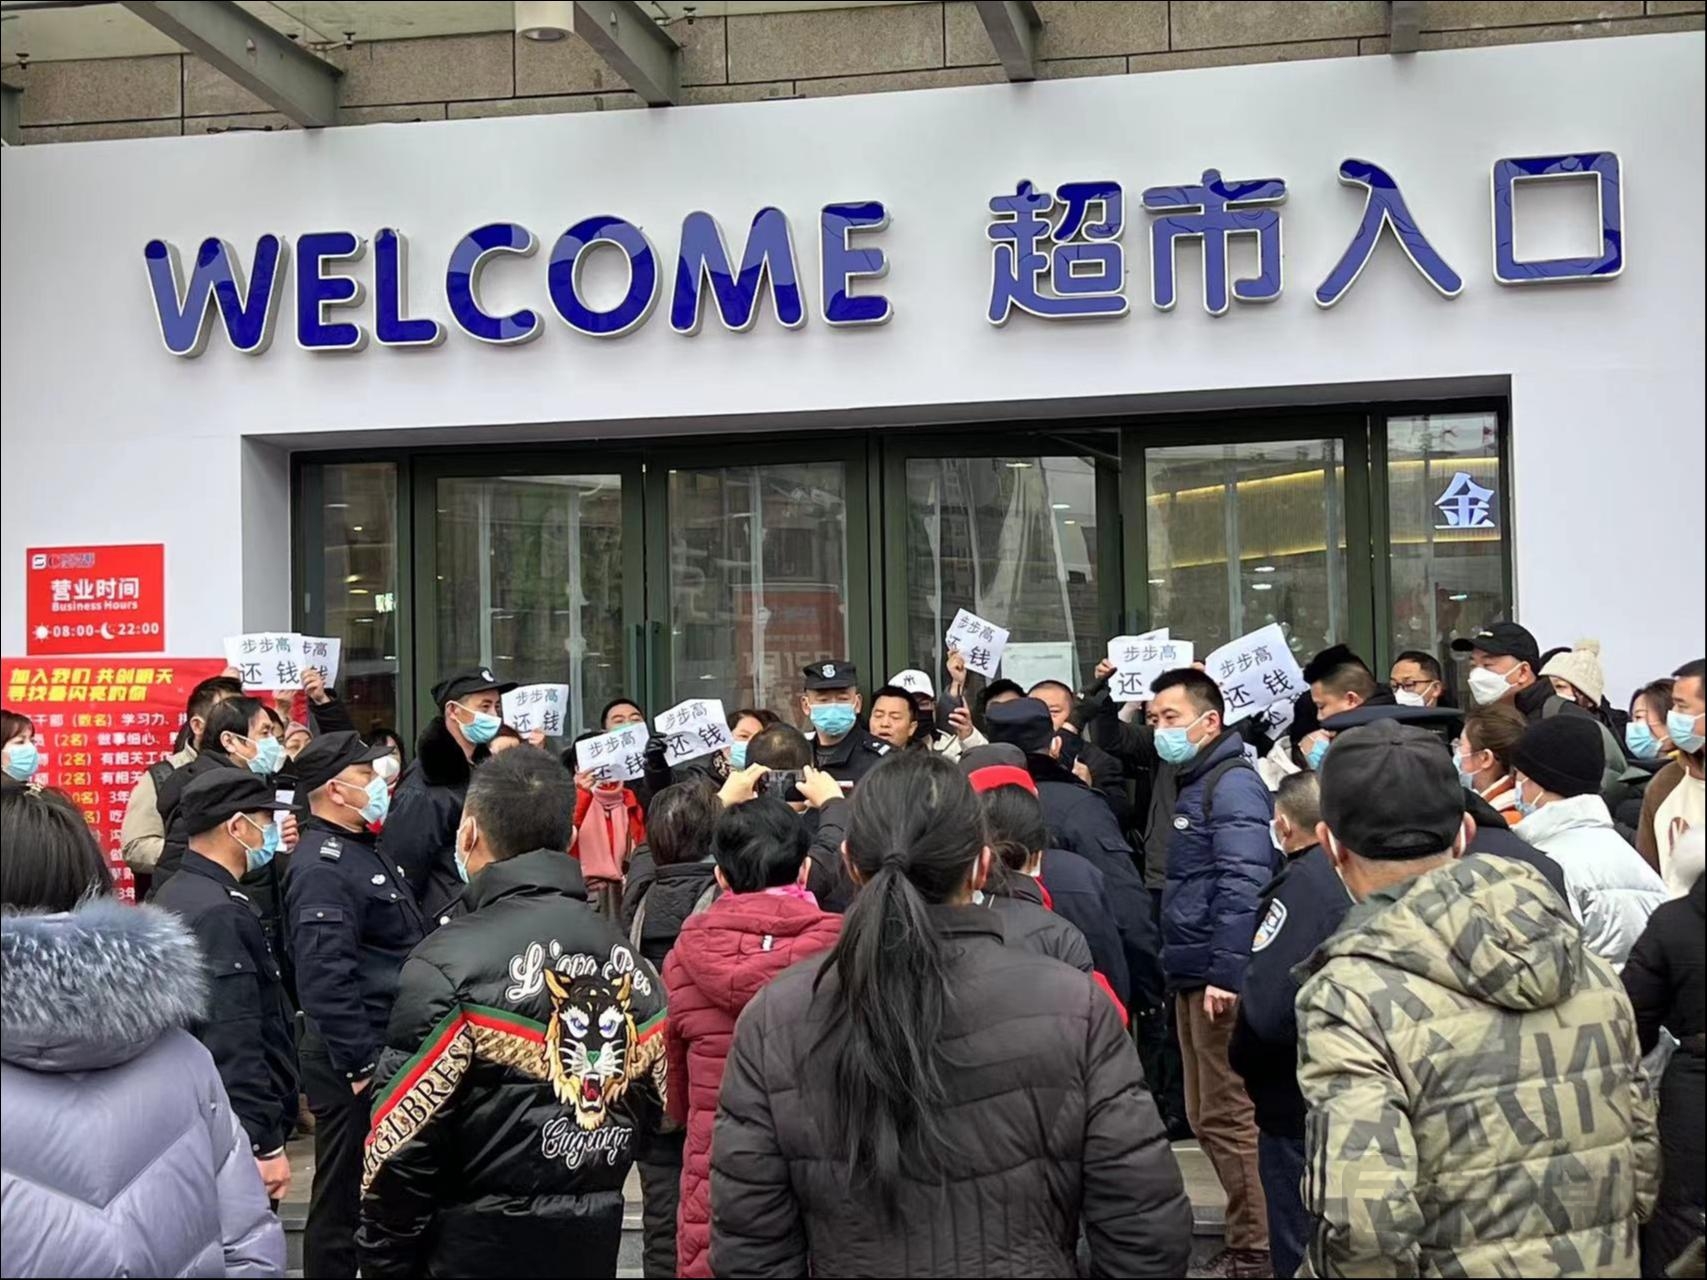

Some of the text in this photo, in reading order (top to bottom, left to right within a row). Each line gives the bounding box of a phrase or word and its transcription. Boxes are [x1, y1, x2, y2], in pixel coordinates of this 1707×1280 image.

[987, 152, 1625, 327] 超市入口
[144, 201, 894, 357] WELCOME
[1434, 472, 1495, 530] 金
[50, 577, 140, 602] 营业时间
[51, 599, 138, 612] Business Hours
[117, 622, 160, 636] 22:00
[957, 615, 995, 643] 步步高
[242, 637, 291, 654] 步步高
[1123, 644, 1177, 662] 步步高
[239, 660, 300, 685] 还钱
[1220, 643, 1272, 679] 步步高
[10, 667, 174, 685] 加入我们 共创明天
[1222, 664, 1295, 712] 还钱
[8, 685, 148, 702] 寻找最闪亮的你
[515, 688, 558, 706] 步步高
[513, 709, 559, 733] 还钱
[665, 701, 708, 731] 步步高
[589, 730, 637, 758] 步步高
[667, 723, 726, 758] 还钱
